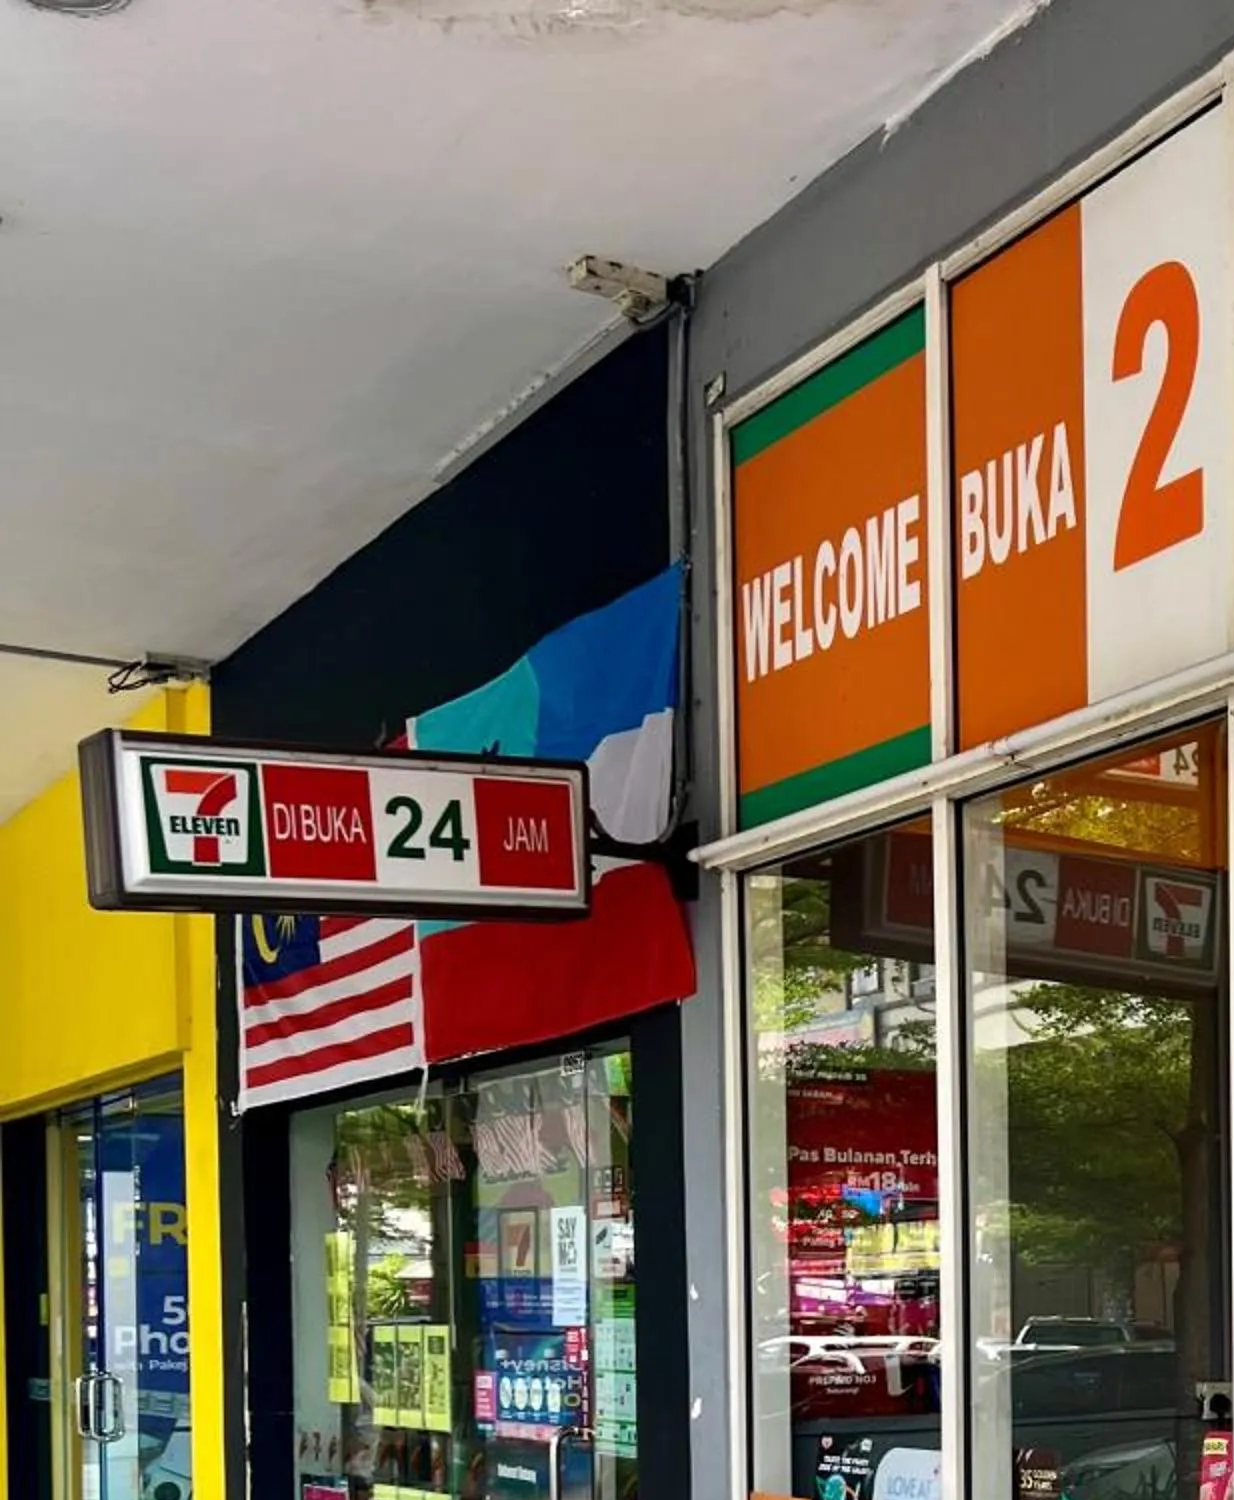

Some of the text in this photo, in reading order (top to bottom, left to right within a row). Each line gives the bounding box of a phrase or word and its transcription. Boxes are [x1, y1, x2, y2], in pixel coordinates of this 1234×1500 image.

[960, 420, 1077, 580] BUKA
[743, 494, 921, 682] WELCOME
[385, 795, 470, 861] 24
[503, 815, 549, 853] JAM
[788, 1146, 820, 1162] Pas
[823, 1147, 898, 1165] Bulanan
